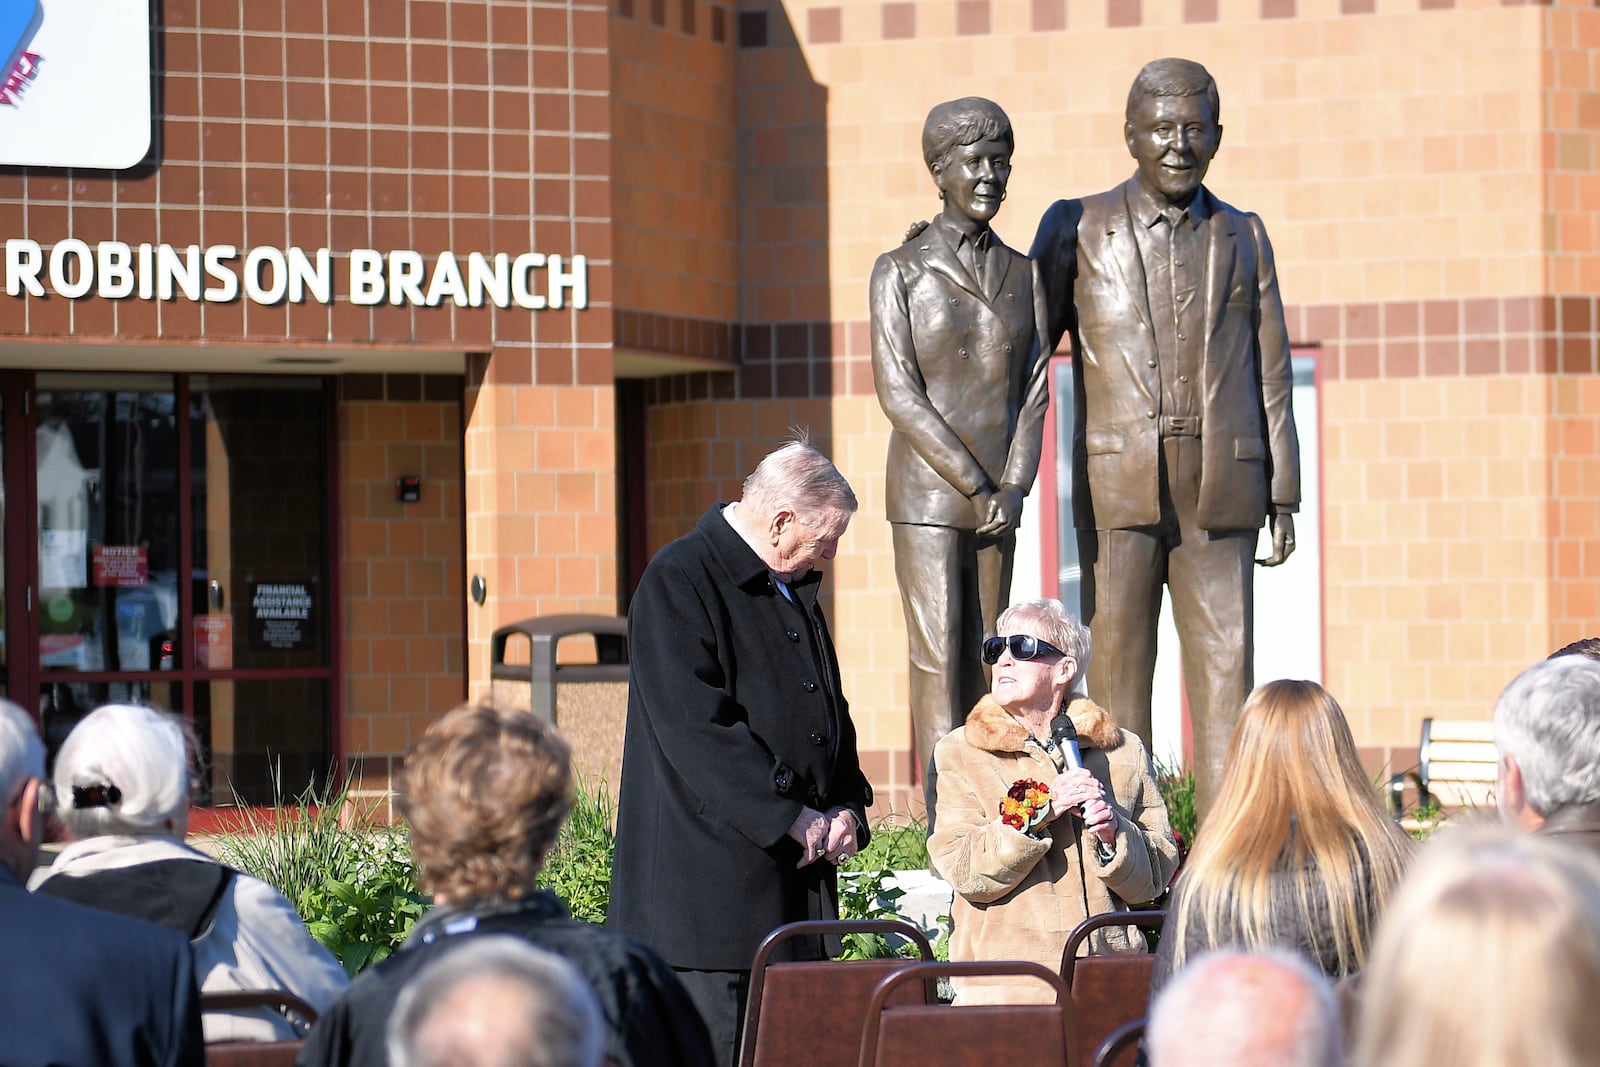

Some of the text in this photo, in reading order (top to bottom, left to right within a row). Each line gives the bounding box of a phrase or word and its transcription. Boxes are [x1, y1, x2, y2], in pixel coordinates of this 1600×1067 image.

[5, 238, 587, 309] ROBINSON BRANCH
[257, 584, 307, 595] FINANCIAL
[253, 595, 312, 608] ASSISTANCE
[256, 607, 309, 619] AVAILABLE
